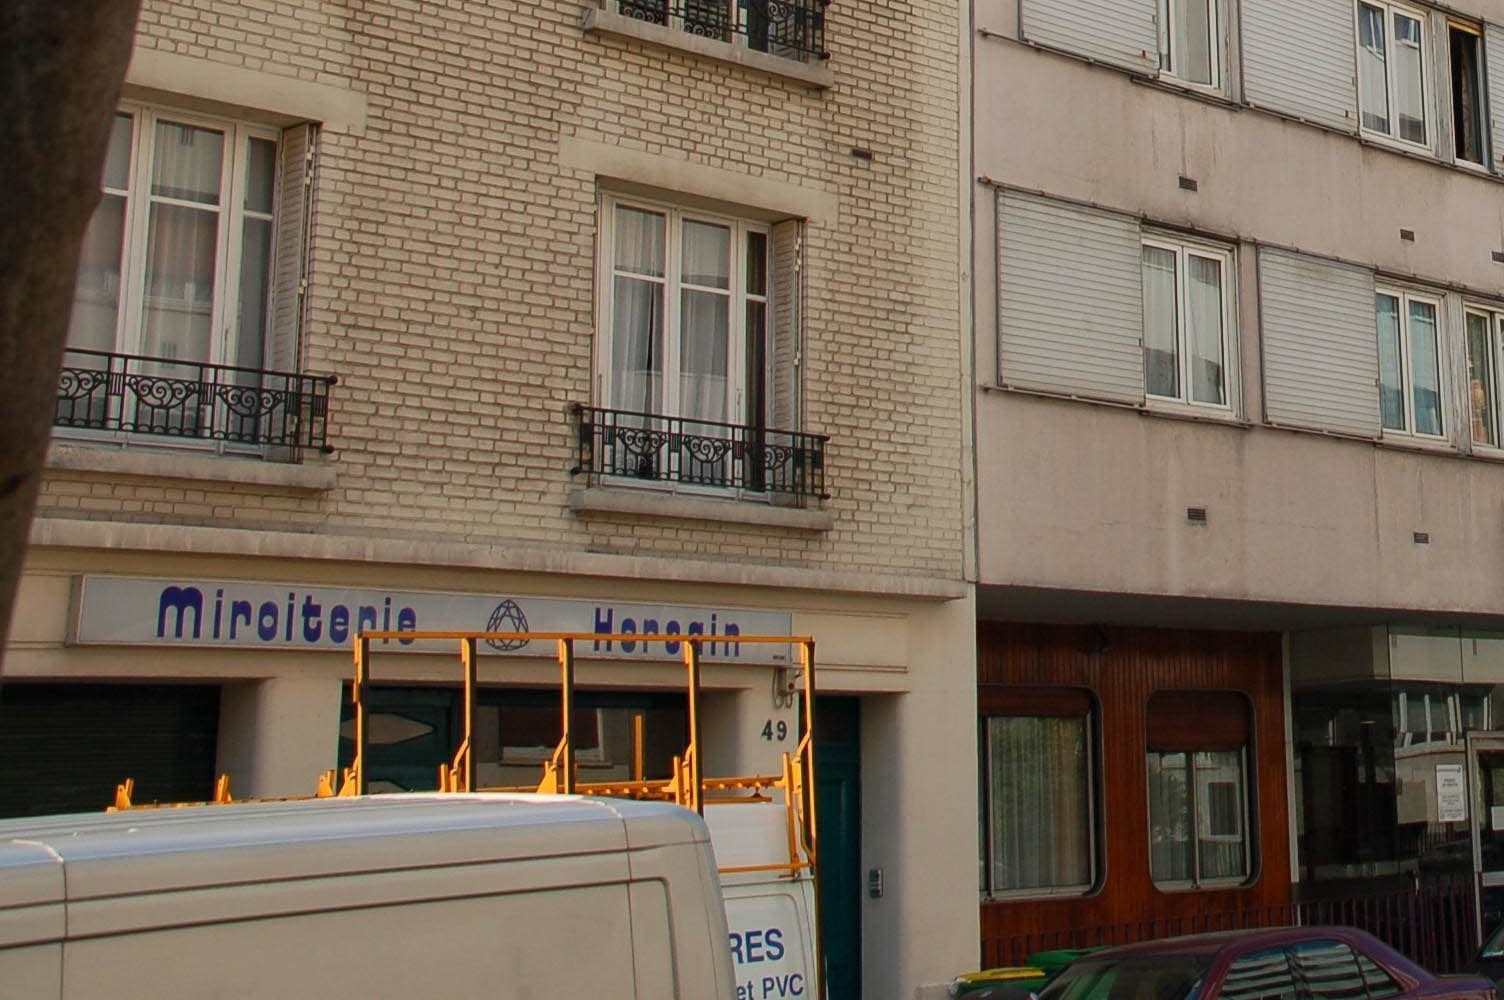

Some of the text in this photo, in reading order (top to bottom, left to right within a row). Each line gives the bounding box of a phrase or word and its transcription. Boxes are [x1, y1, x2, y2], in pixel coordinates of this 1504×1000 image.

[157, 586, 417, 646] Miroiterie
[761, 719, 787, 741] 49
[762, 973, 804, 999] PVC
